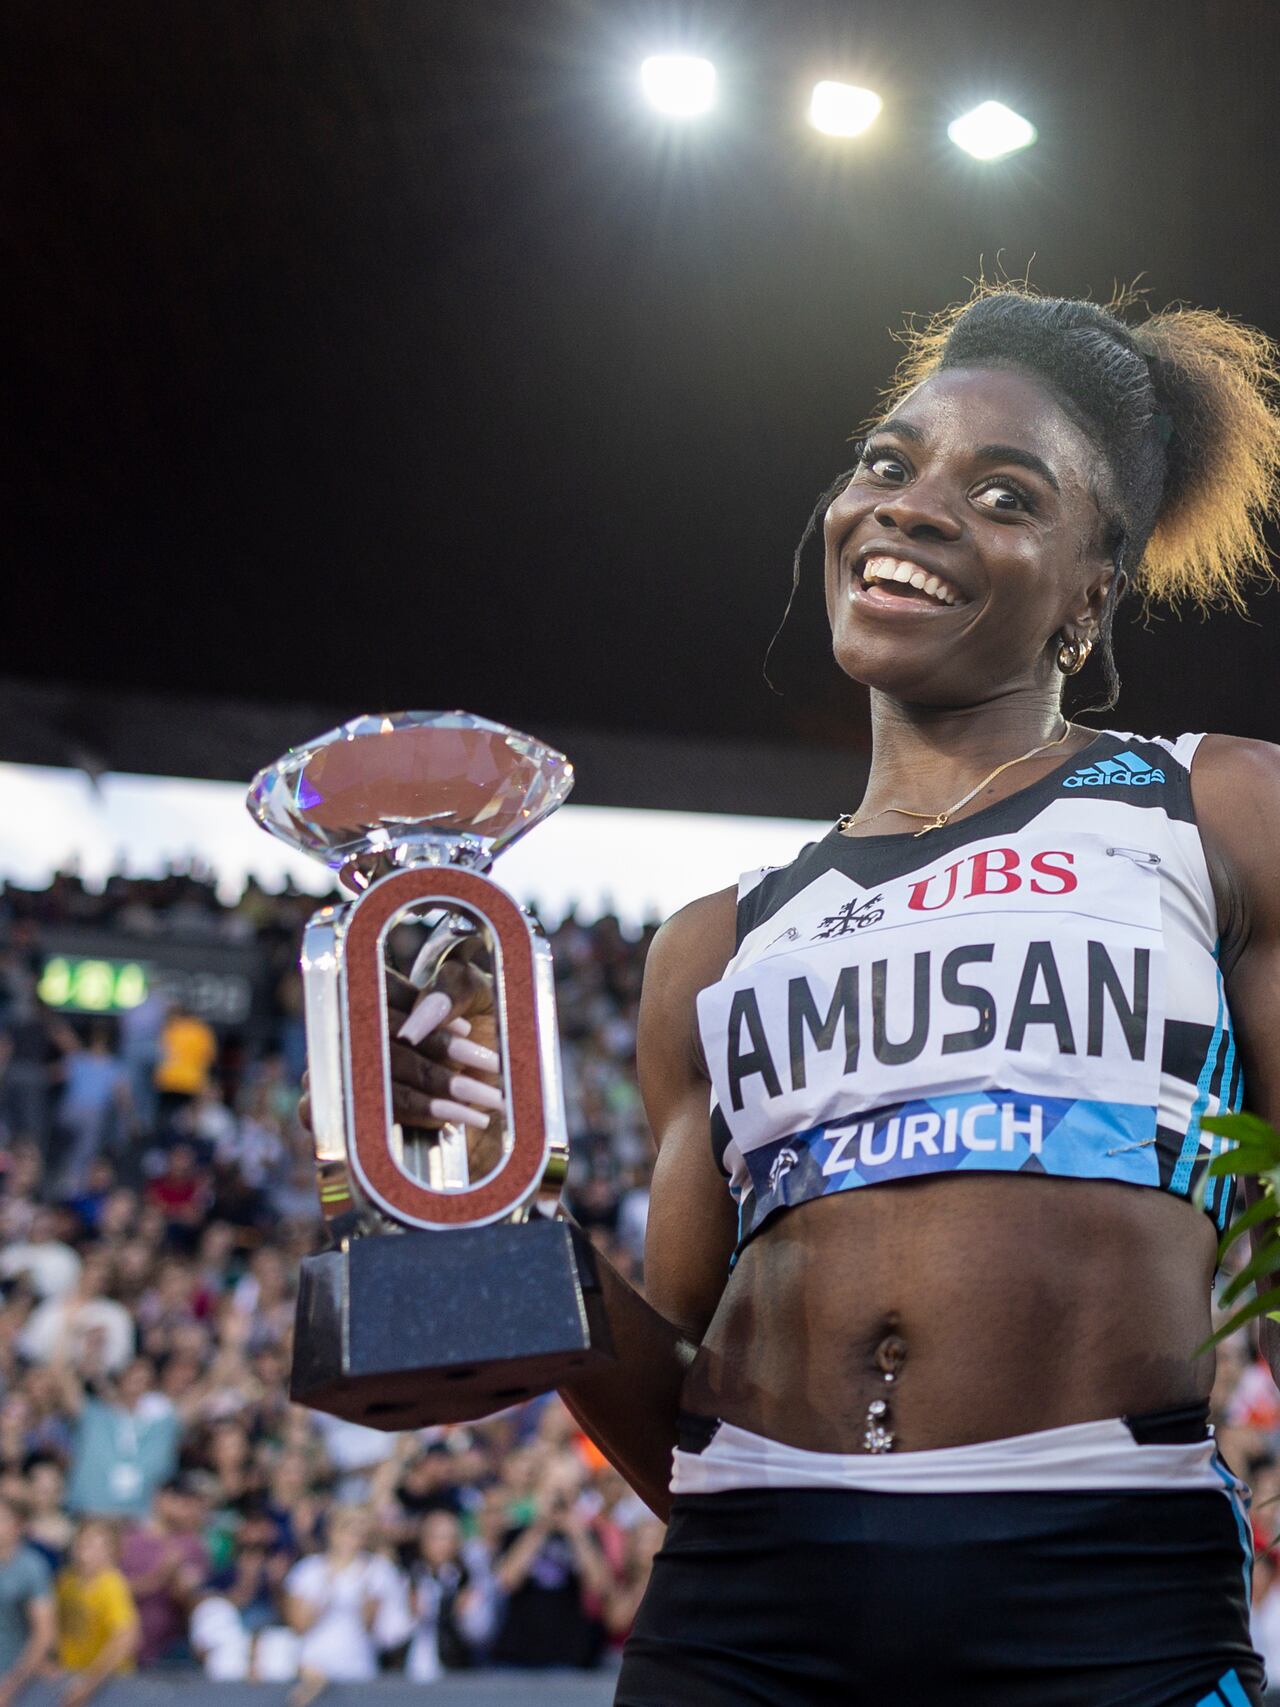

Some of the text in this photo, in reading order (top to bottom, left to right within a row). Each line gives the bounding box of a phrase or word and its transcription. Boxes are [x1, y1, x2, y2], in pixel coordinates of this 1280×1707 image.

[1062, 767, 1166, 788] adidas
[907, 848, 1078, 911] UBS
[727, 940, 1150, 1112] AMUSAN
[821, 1103, 1043, 1175] ZURICH
